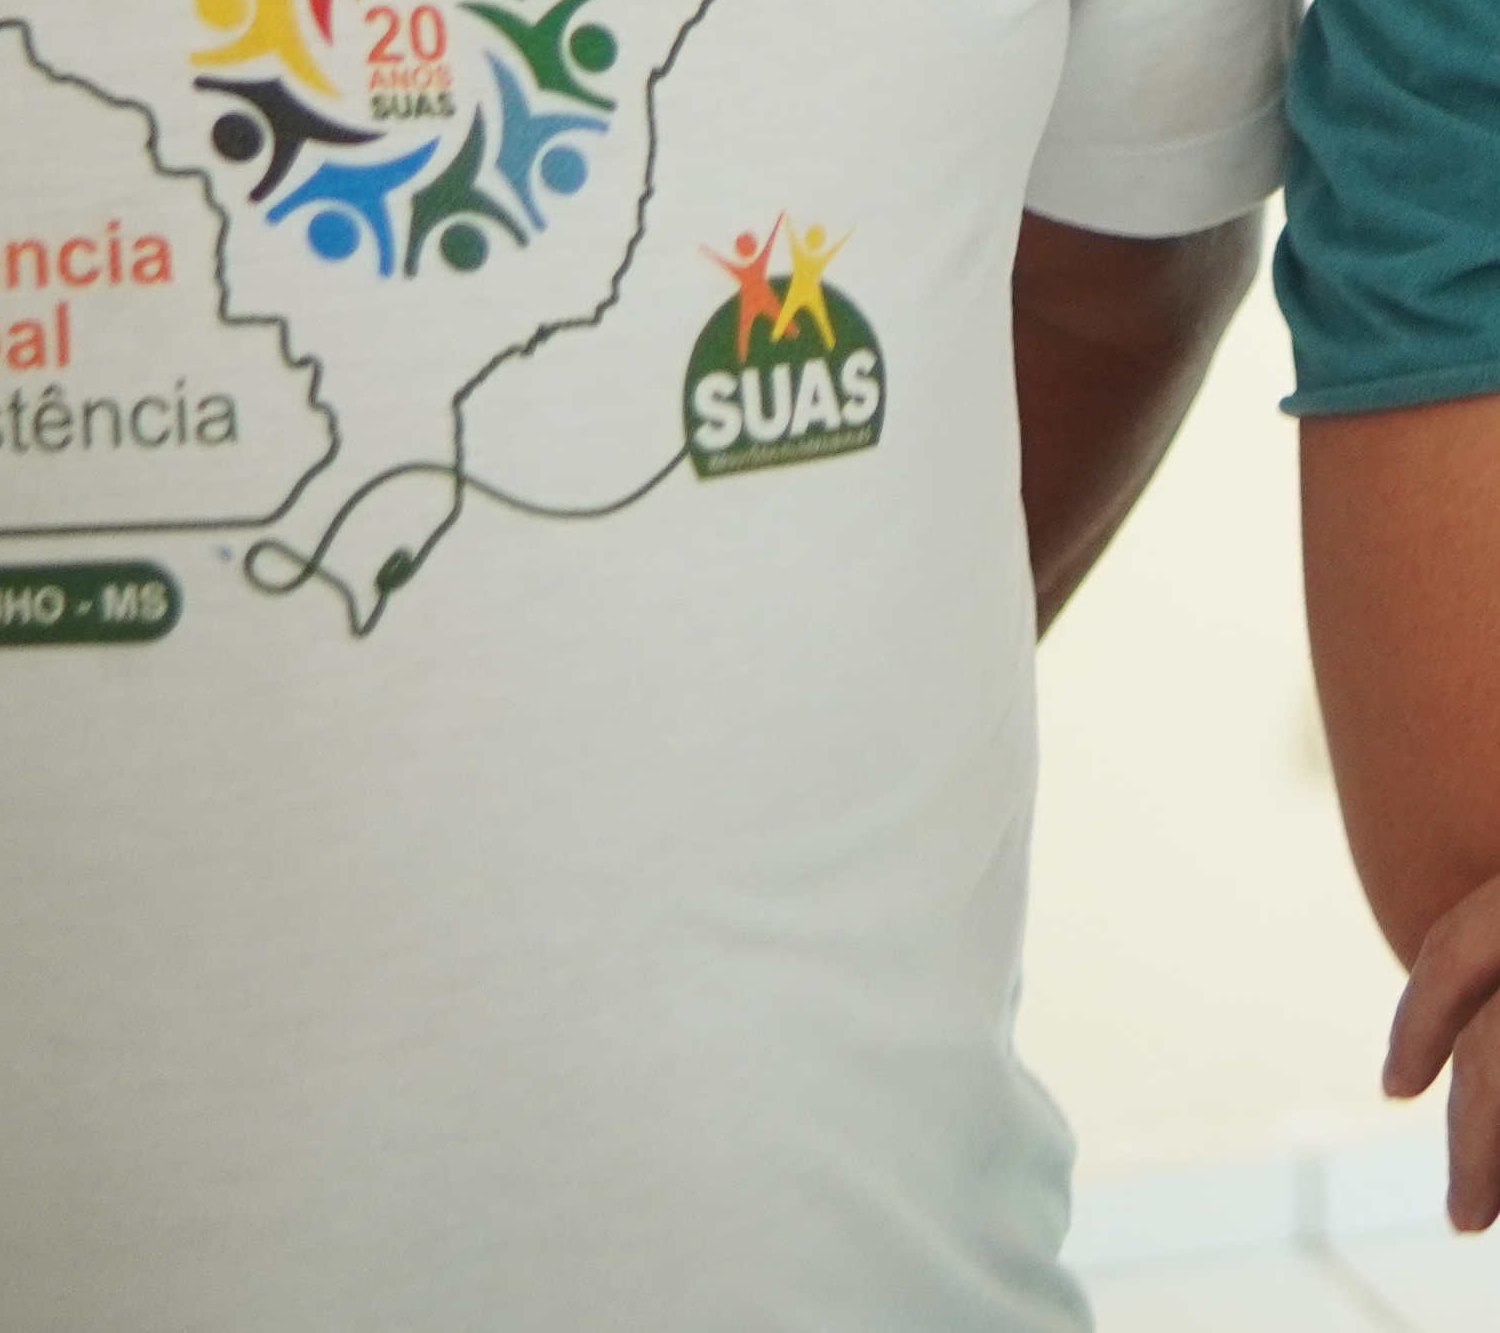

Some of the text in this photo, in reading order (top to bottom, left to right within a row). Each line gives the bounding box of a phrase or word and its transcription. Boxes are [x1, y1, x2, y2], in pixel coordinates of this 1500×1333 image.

[364, 3, 448, 64] 20
[368, 65, 452, 92] ANOS
[370, 90, 457, 121] SUAS
[692, 347, 882, 452] SUAS
[100, 579, 171, 624] MS
